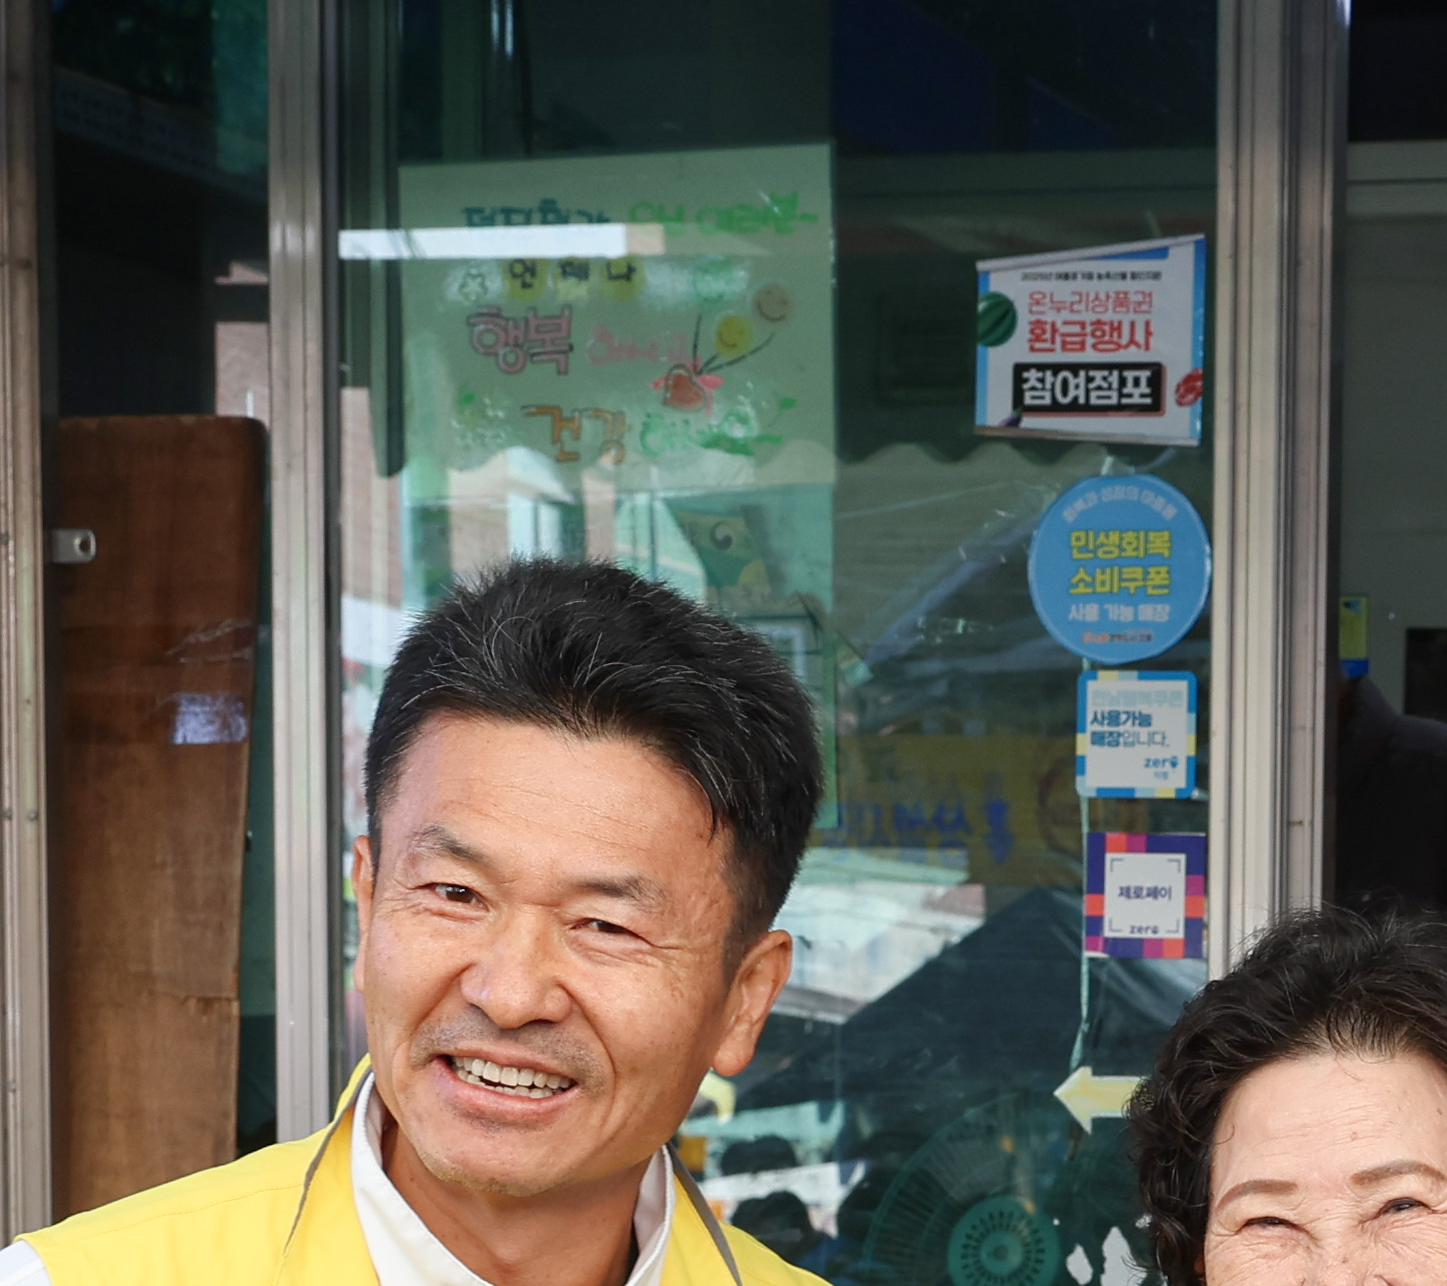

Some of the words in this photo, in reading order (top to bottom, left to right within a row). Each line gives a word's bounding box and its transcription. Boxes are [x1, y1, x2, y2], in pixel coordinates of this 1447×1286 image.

[1028, 290, 1153, 314] 온누리상품권
[467, 304, 574, 375] 행복
[1028, 319, 1154, 353] 환급행사
[1022, 368, 1152, 406] 참여점포
[1070, 530, 1171, 559] 민생회복
[1069, 566, 1170, 595] 소비쿠폰
[1069, 603, 1099, 621] 사용
[1104, 604, 1135, 622] 가능
[1138, 603, 1170, 622] 매장
[1091, 710, 1152, 727] 사용가능
[1090, 731, 1169, 748] 매장입니다.
[1118, 886, 1172, 900] 제로페이
